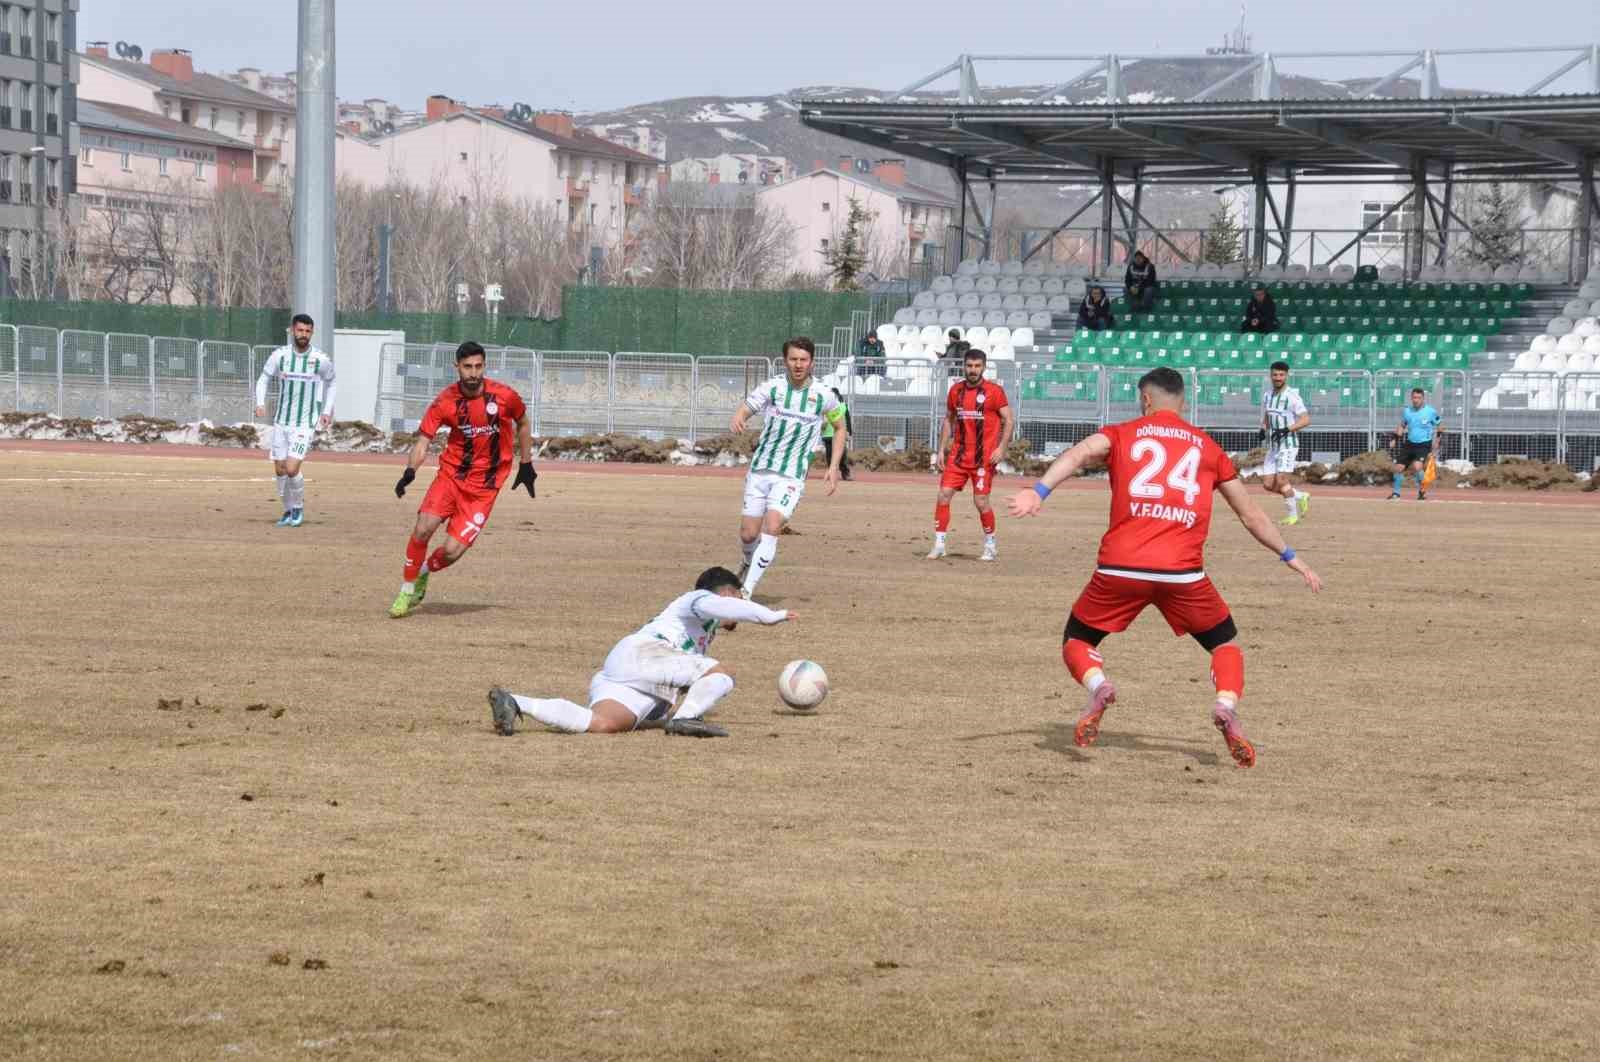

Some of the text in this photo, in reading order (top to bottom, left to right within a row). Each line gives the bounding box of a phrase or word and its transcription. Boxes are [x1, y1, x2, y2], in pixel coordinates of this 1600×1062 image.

[292, 442, 305, 455] 36
[1129, 438, 1201, 505] 24
[976, 477, 985, 491] 4
[780, 494, 791, 506] 5
[460, 521, 481, 542] 77
